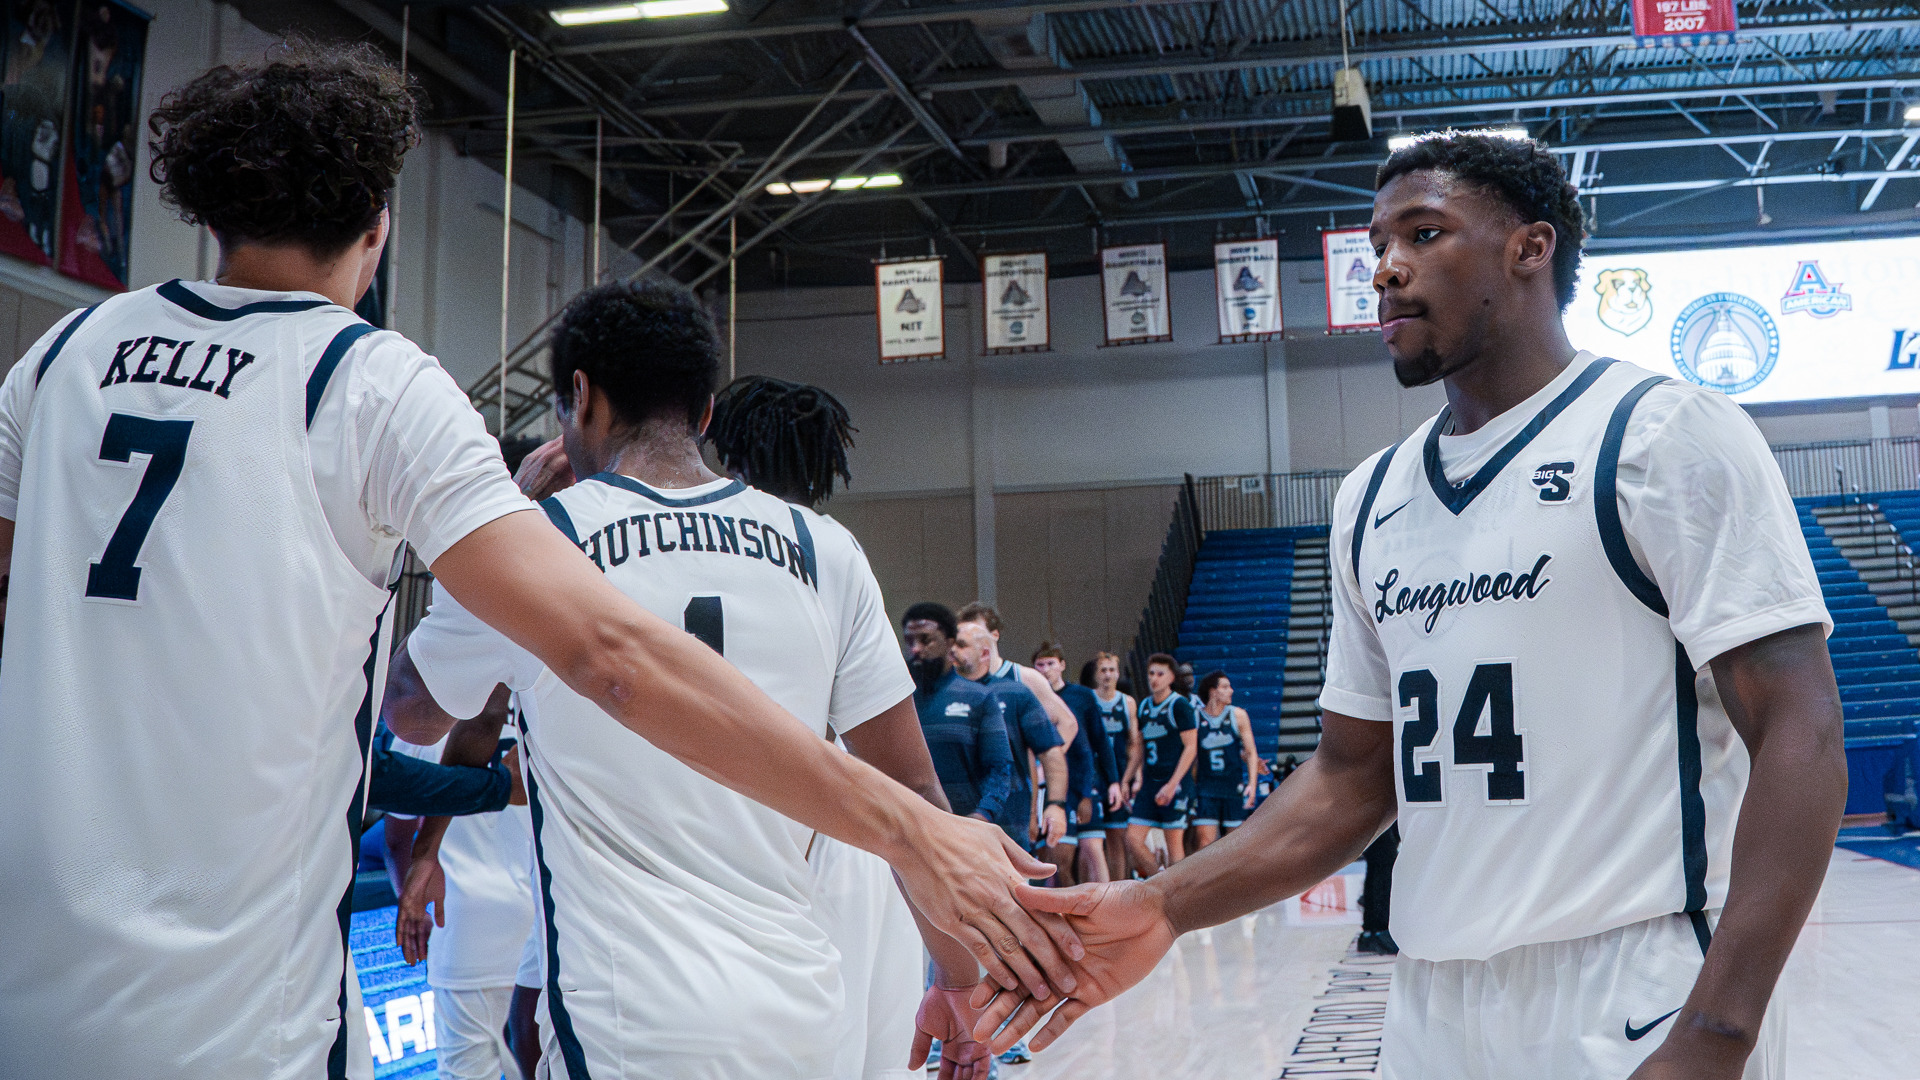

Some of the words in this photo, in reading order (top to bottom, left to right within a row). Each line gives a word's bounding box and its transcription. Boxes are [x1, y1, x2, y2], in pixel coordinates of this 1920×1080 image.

[1664, 16, 1706, 31] 2007
[1784, 294, 1848, 311] AMERICAN
[901, 320, 922, 332] NIT
[99, 335, 256, 399] KELLY
[1531, 469, 1555, 480] BIG
[85, 412, 195, 601] 7
[581, 511, 810, 586] HUTCHINSON
[1374, 554, 1553, 634] Longwood
[1397, 662, 1526, 803] 24
[1146, 741, 1159, 765] 3
[1209, 749, 1225, 771] 5
